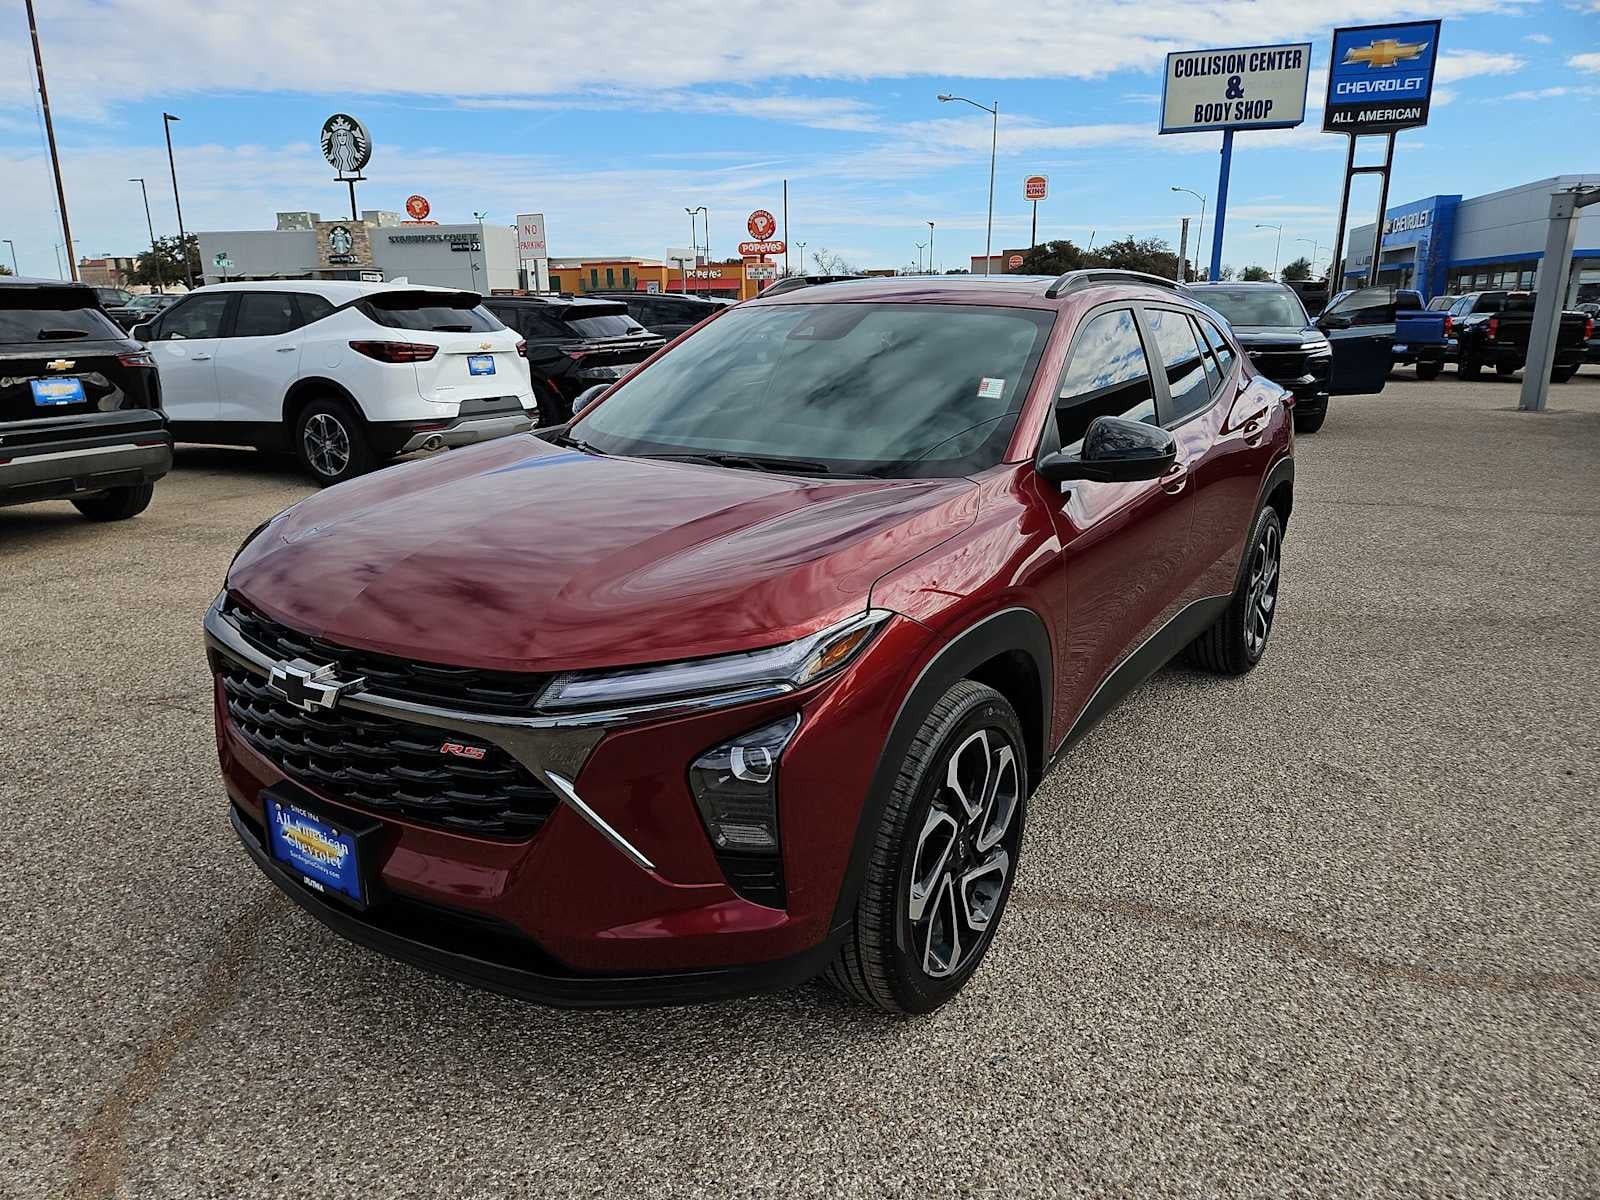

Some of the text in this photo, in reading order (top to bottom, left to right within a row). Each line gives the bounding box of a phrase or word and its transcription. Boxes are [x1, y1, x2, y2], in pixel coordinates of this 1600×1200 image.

[1174, 49, 1302, 78] COLLISION CENTER
[1225, 75, 1245, 99] &
[1336, 77, 1424, 95] CHEVROLET
[1194, 99, 1273, 123] BODY SHOP
[1332, 107, 1421, 124] ALL AMERICAN
[524, 224, 538, 235] NO
[1391, 209, 1429, 233] CHEVROLET
[520, 240, 545, 250] PARKING
[440, 743, 486, 759] RS
[276, 811, 349, 855] All American
[287, 832, 342, 869] Chevrolet
